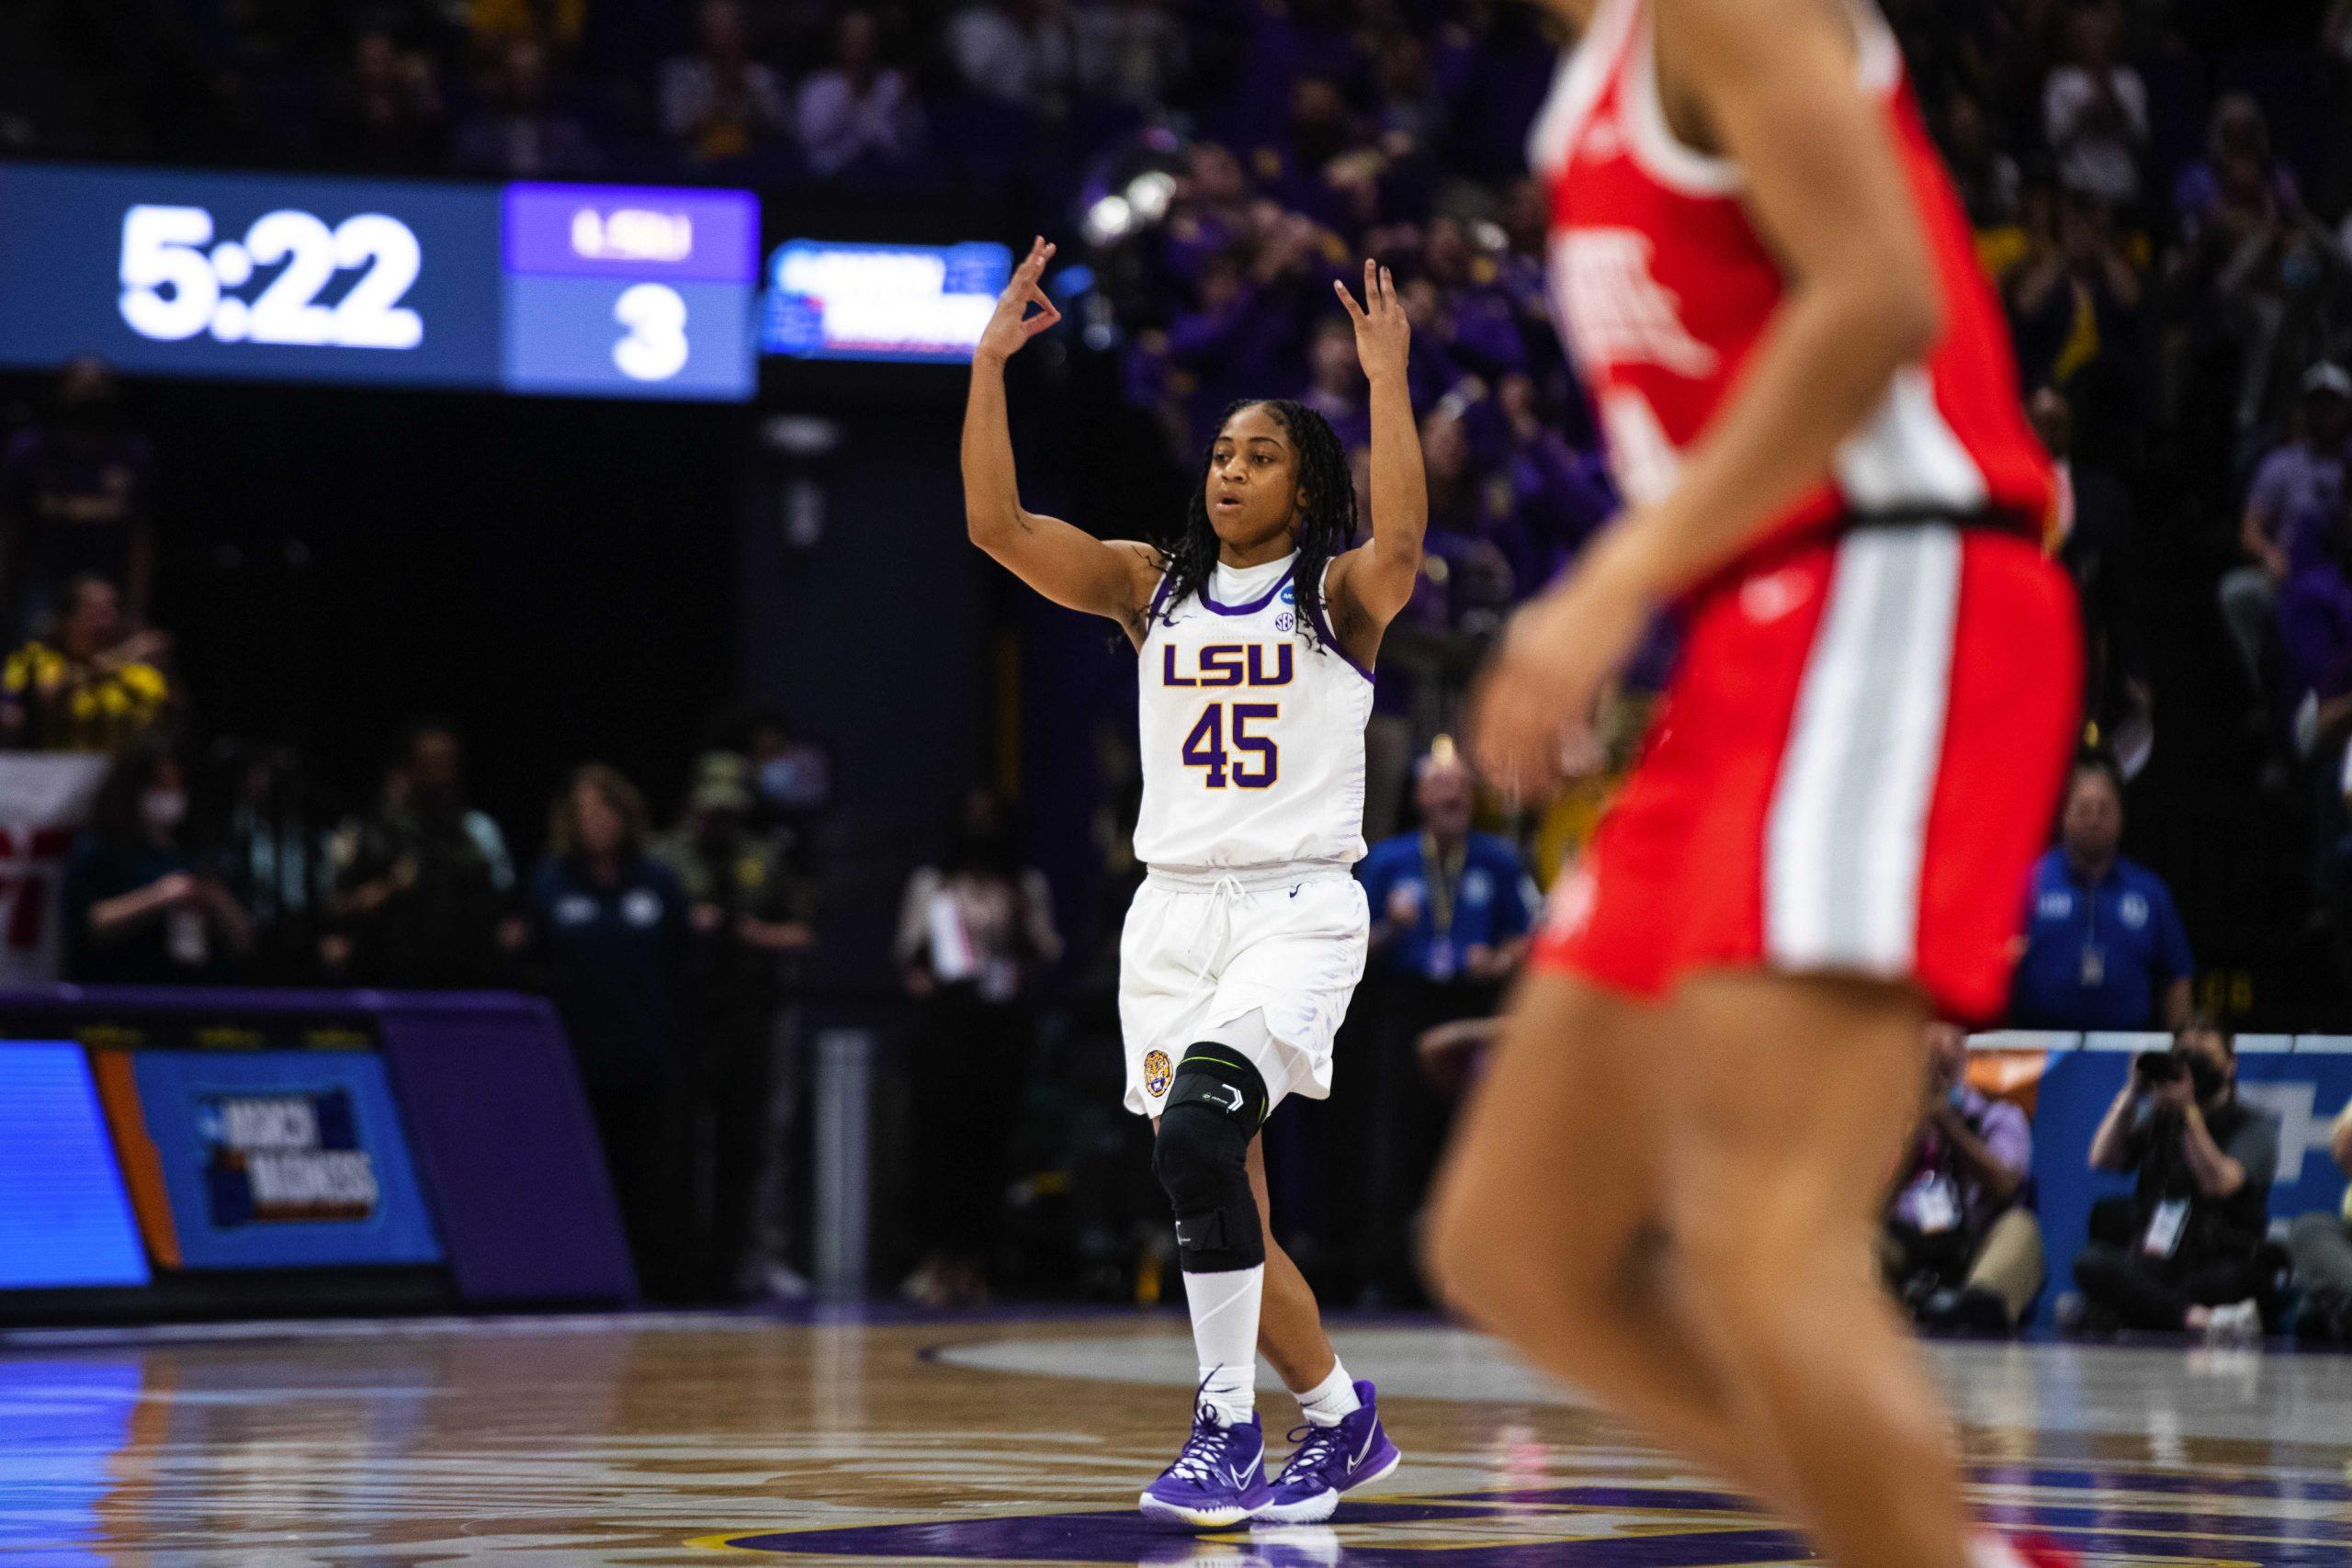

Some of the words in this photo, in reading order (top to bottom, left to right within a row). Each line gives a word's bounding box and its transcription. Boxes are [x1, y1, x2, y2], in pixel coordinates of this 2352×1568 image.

[119, 204, 424, 349] 5:22
[612, 282, 688, 381] 3
[1162, 642, 1295, 687] LSU
[1276, 613, 1294, 631] SEC
[1182, 701, 1280, 789] 45
